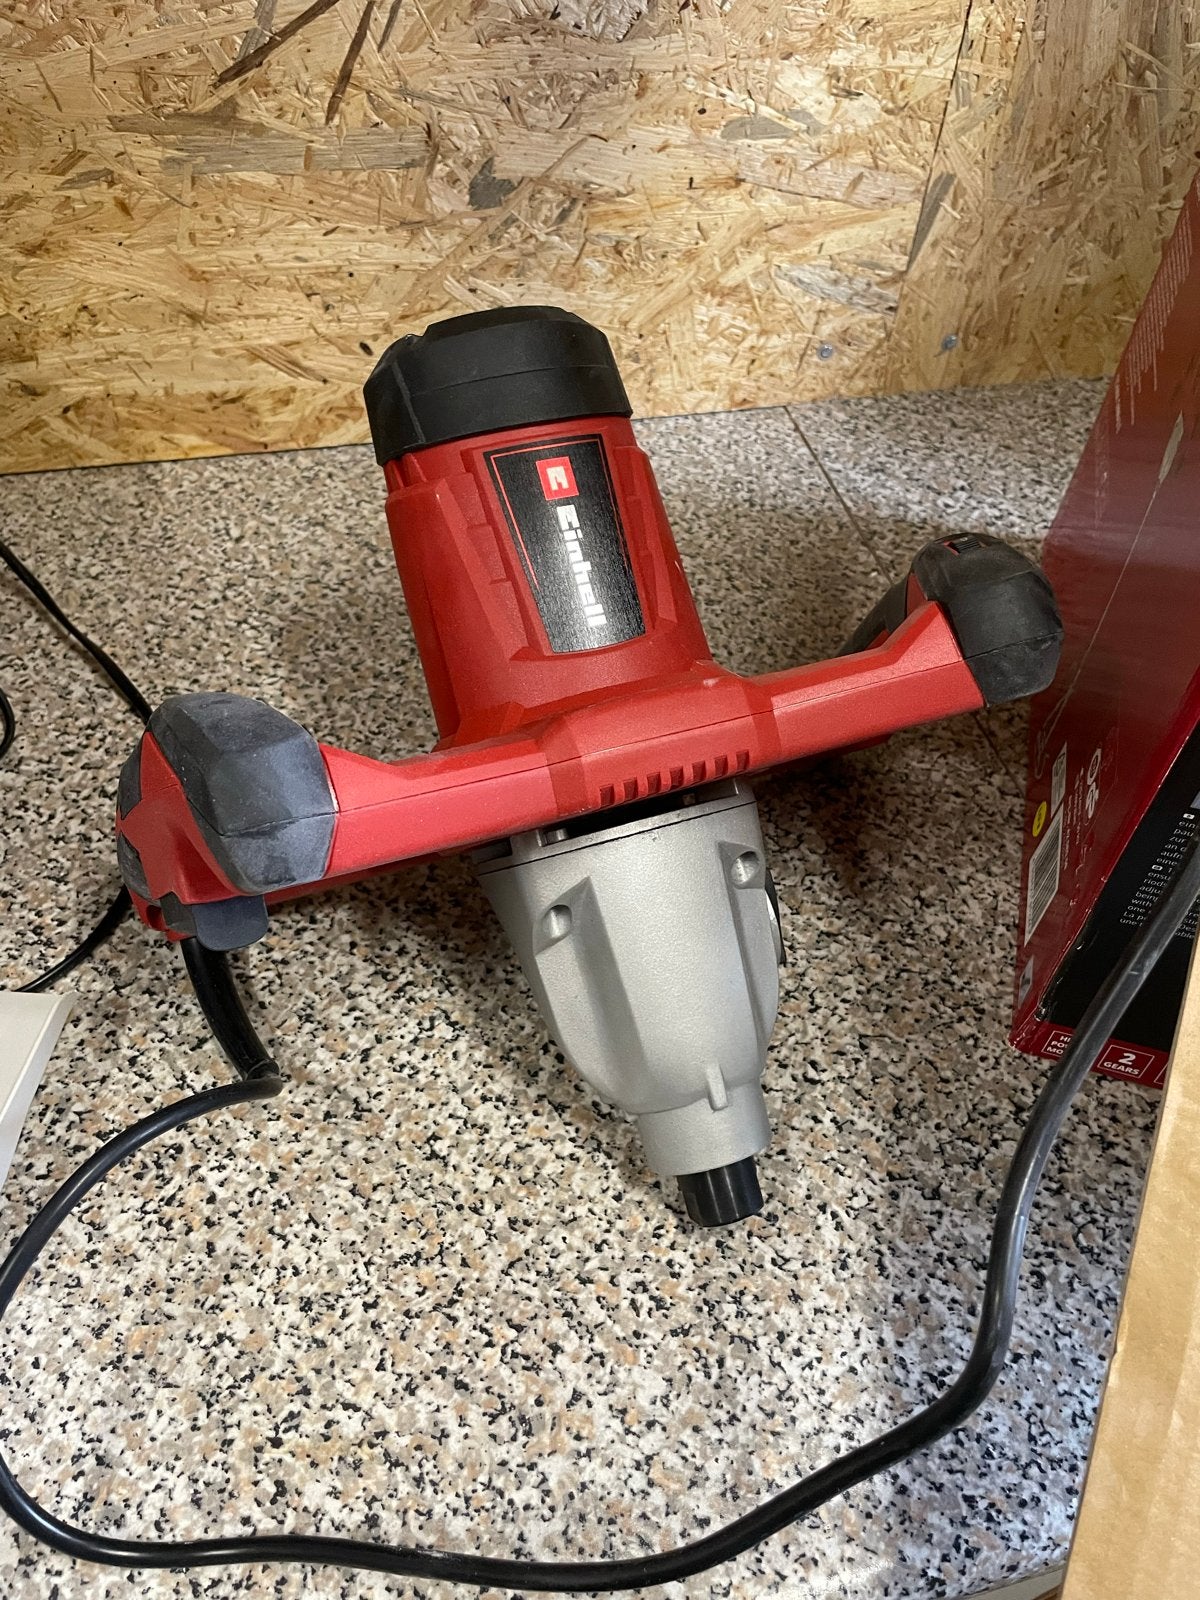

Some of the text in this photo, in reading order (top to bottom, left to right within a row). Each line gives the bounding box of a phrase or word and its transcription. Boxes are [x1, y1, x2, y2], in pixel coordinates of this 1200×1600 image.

[556, 504, 607, 627] Einhell
[1118, 1052, 1136, 1066] 2
[1103, 1061, 1140, 1076] GEARS
